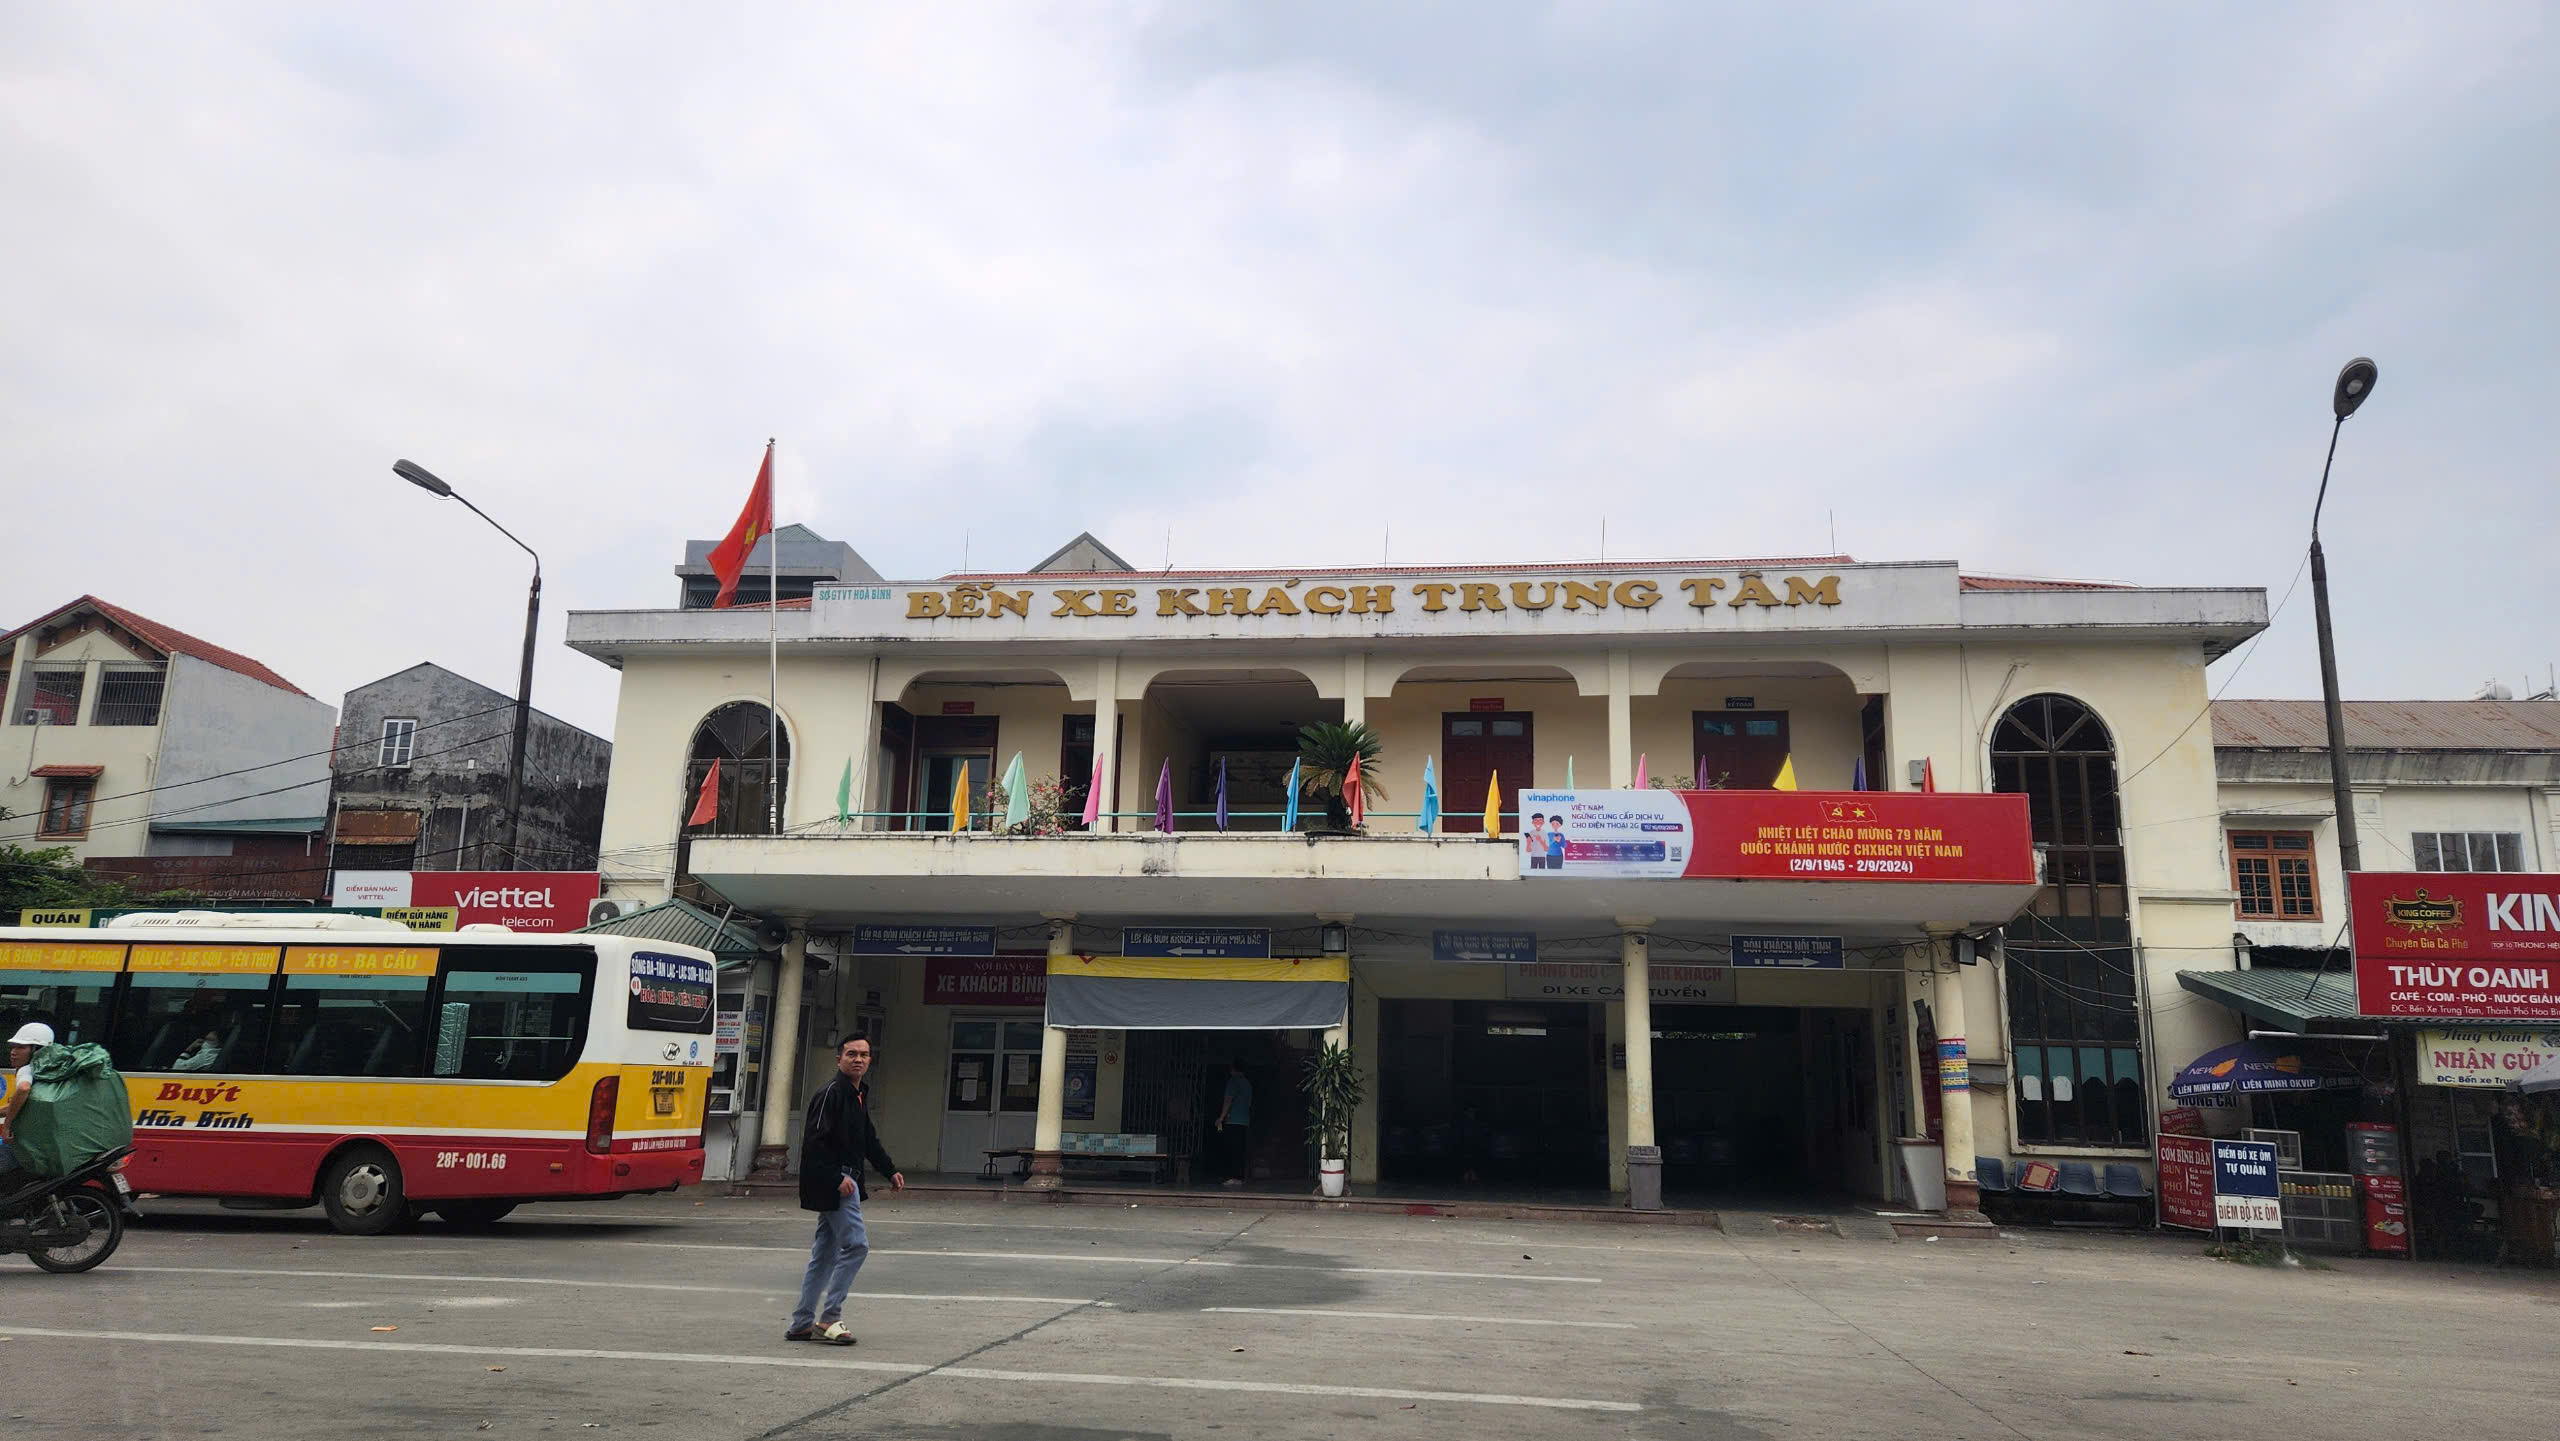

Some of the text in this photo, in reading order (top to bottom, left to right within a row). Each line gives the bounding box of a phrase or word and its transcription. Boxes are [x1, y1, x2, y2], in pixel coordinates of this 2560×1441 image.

[905, 570, 1842, 619] BẾN XE KHÁCH TRUNG TÂM
[1528, 793, 1575, 803] vinaphone
[1571, 804, 1586, 812] VIỆT
[1619, 811, 1634, 820] CẤP
[1758, 825, 1942, 842] NHIỆT LIỆT CHÀO MỪNG 79 NĂM
[1740, 839, 1962, 859] QUỐC KHÁNH NƯỚC CHXHCN VIỆT NAM
[1789, 859, 1914, 874] (2/9/1945 2/9/2024)
[454, 887, 555, 908] viettel
[32, 911, 81, 924] QUÁN
[386, 909, 407, 919] ĐIỂM
[425, 910, 448, 919] HÀNG
[2398, 909, 2452, 918] KING COFFEE
[419, 919, 441, 928] HÀNG
[502, 916, 554, 928] telecom
[1763, 938, 1792, 953] KHÁCH
[2385, 936, 2418, 949] Chuyên
[2420, 937, 2435, 949] Gia
[304, 948, 419, 970] X18 BA CẦU
[936, 974, 955, 992] XE
[959, 972, 1008, 992] KHÁCH
[2388, 963, 2548, 989] THÙY OANH
[1543, 985, 1561, 994] ĐI
[1567, 986, 1590, 995] XE
[2439, 1005, 2462, 1015] Trung
[2433, 1047, 2496, 1074] NHẬN
[2243, 1078, 2262, 1089] LIÊN
[2264, 1079, 2288, 1089] MINH
[2290, 1079, 2316, 1088] OKVIP
[2437, 1075, 2456, 1083] ĐC:
[2458, 1074, 2477, 1084] Bến
[156, 1082, 242, 1105] Buýt
[2218, 1144, 2236, 1160] ĐIỂM
[2249, 1151, 2258, 1160] XE
[436, 1151, 507, 1169] 28F-001.66
[2225, 1162, 2238, 1176] TỰ
[2218, 1202, 2238, 1220] ĐIỂM
[2253, 1207, 2263, 1220] XE
